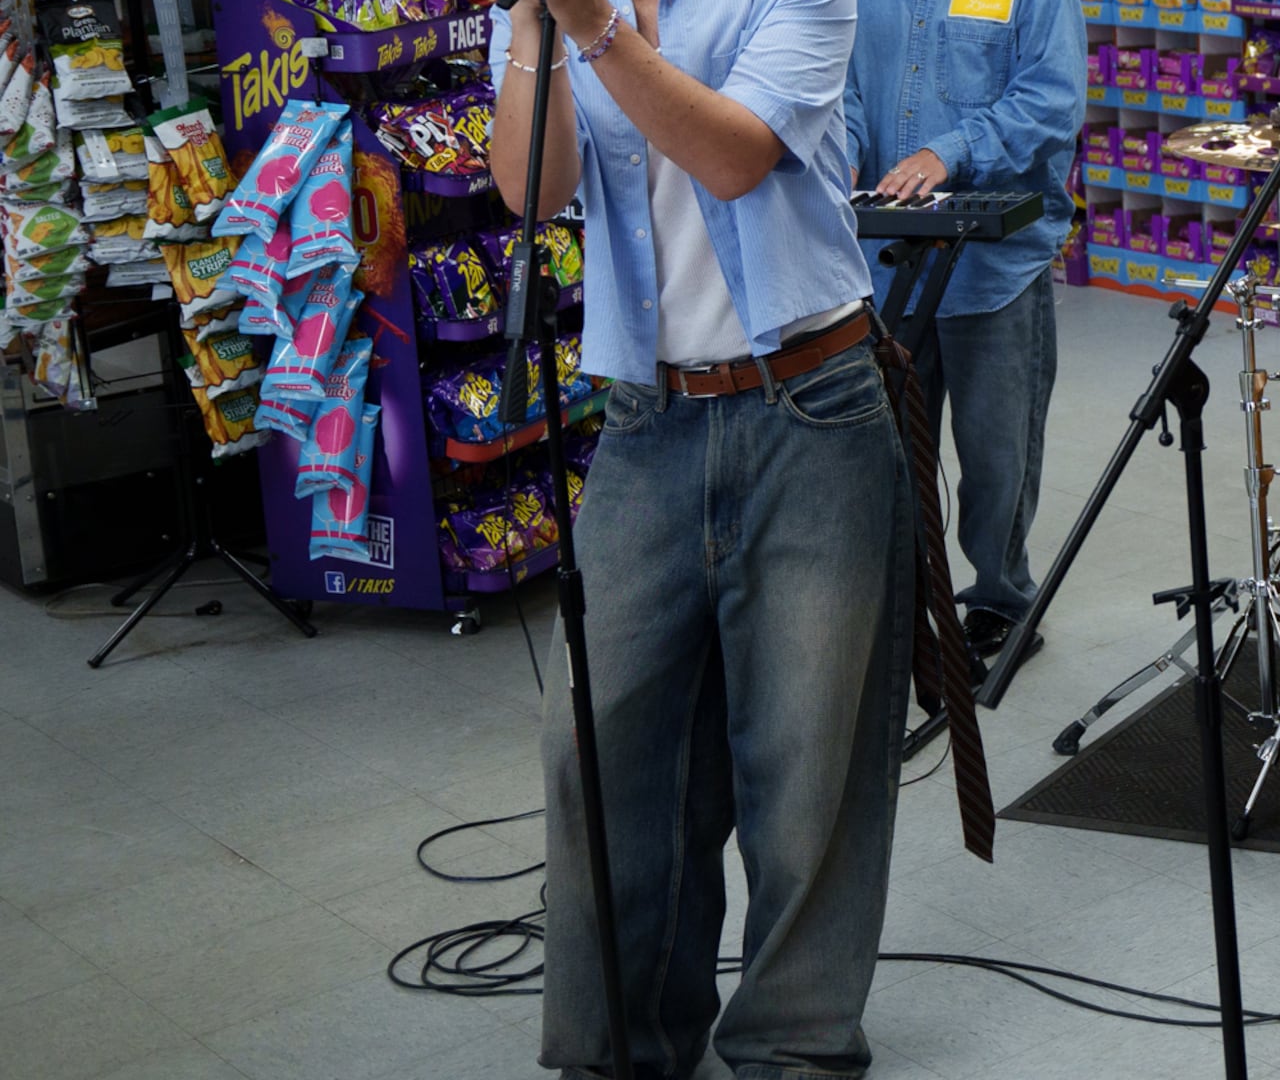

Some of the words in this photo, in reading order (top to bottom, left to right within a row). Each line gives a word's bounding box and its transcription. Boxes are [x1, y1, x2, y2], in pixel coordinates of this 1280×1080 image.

[62, 23, 111, 40] Plantain
[449, 15, 486, 52] FACE
[377, 38, 404, 70] Takis
[413, 34, 438, 62] Takis
[222, 37, 310, 132] Takis
[309, 163, 345, 176] andy
[189, 248, 230, 270] PLANTAIN
[191, 257, 233, 278] STRIPS
[307, 292, 340, 308] andy
[216, 339, 254, 359] STRIPS
[324, 386, 357, 401] andy
[223, 402, 258, 422] STRIPS
